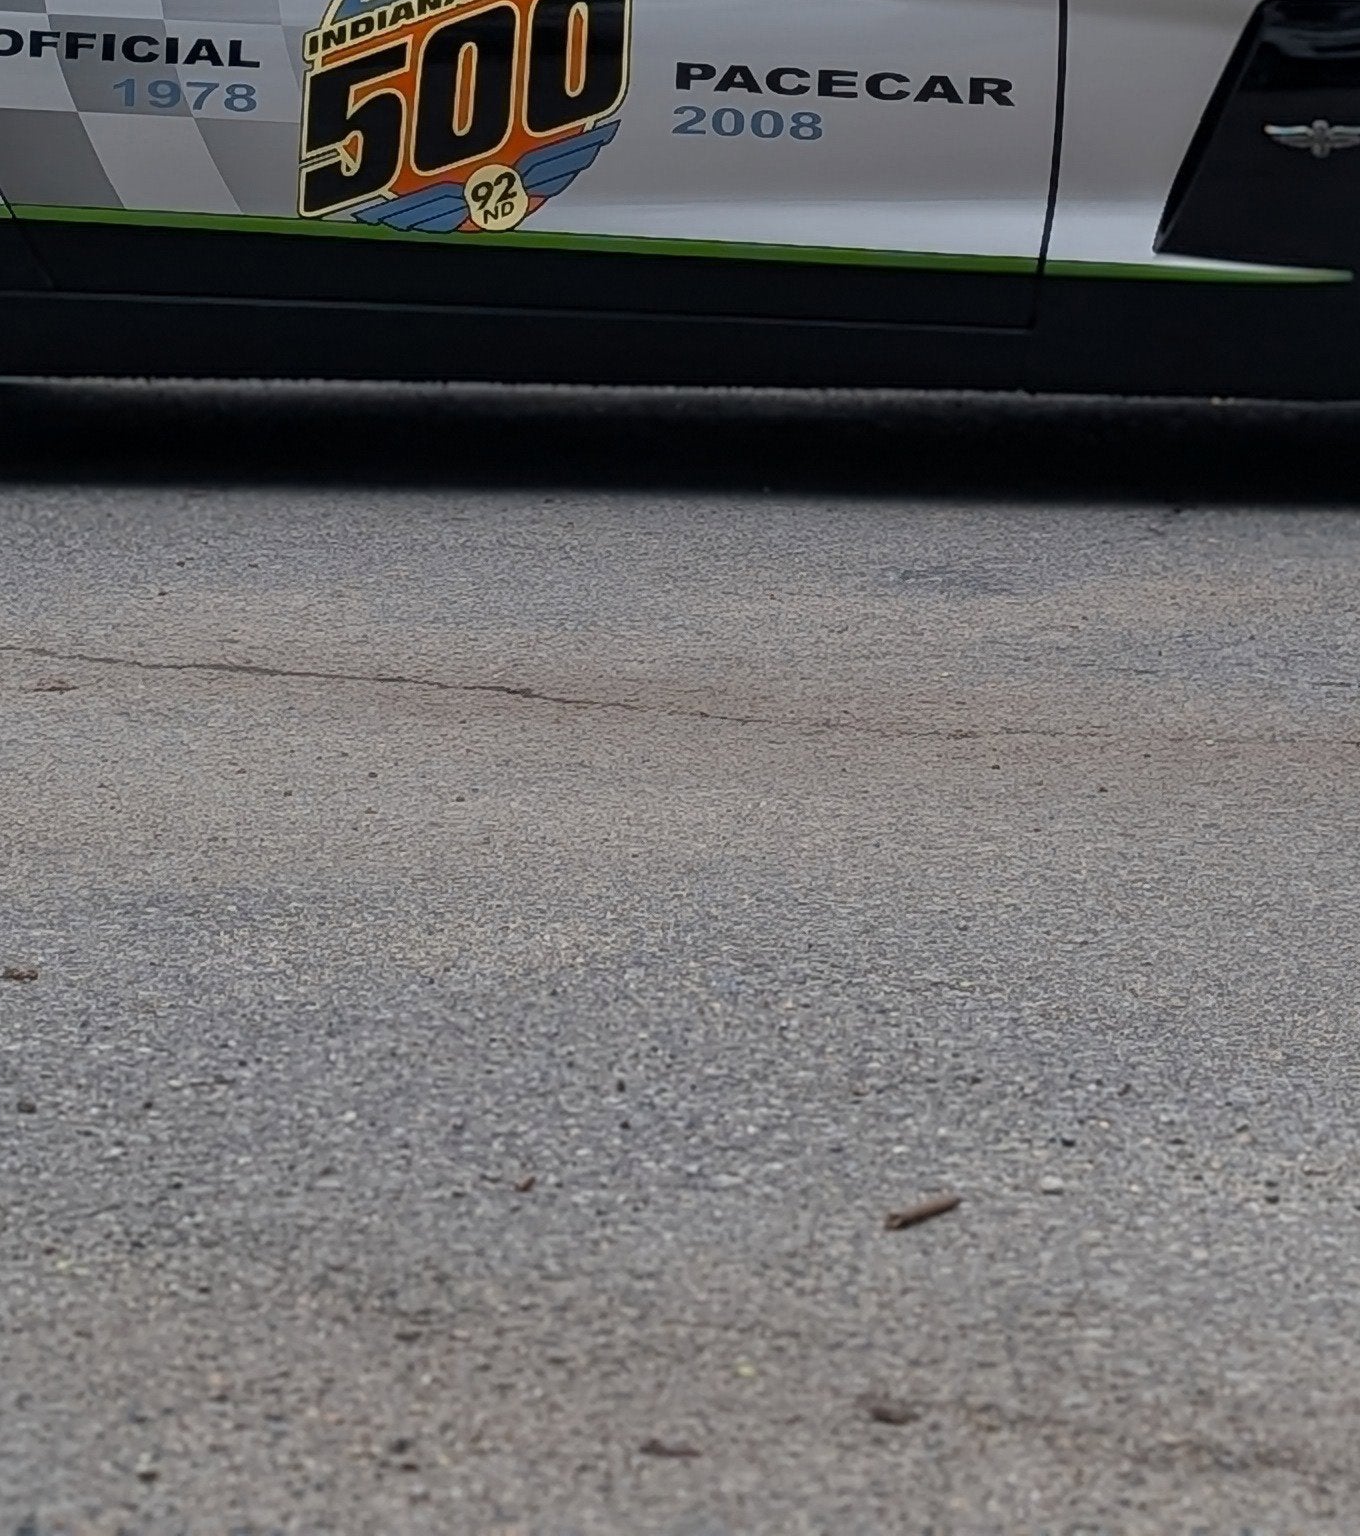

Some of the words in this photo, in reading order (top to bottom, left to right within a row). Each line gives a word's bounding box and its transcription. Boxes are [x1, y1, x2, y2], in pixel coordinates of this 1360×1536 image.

[112, 77, 258, 113] 1978
[675, 61, 1015, 107] PACECAR
[671, 104, 823, 141] 2008
[470, 172, 518, 212] 92
[482, 200, 516, 225] ND
